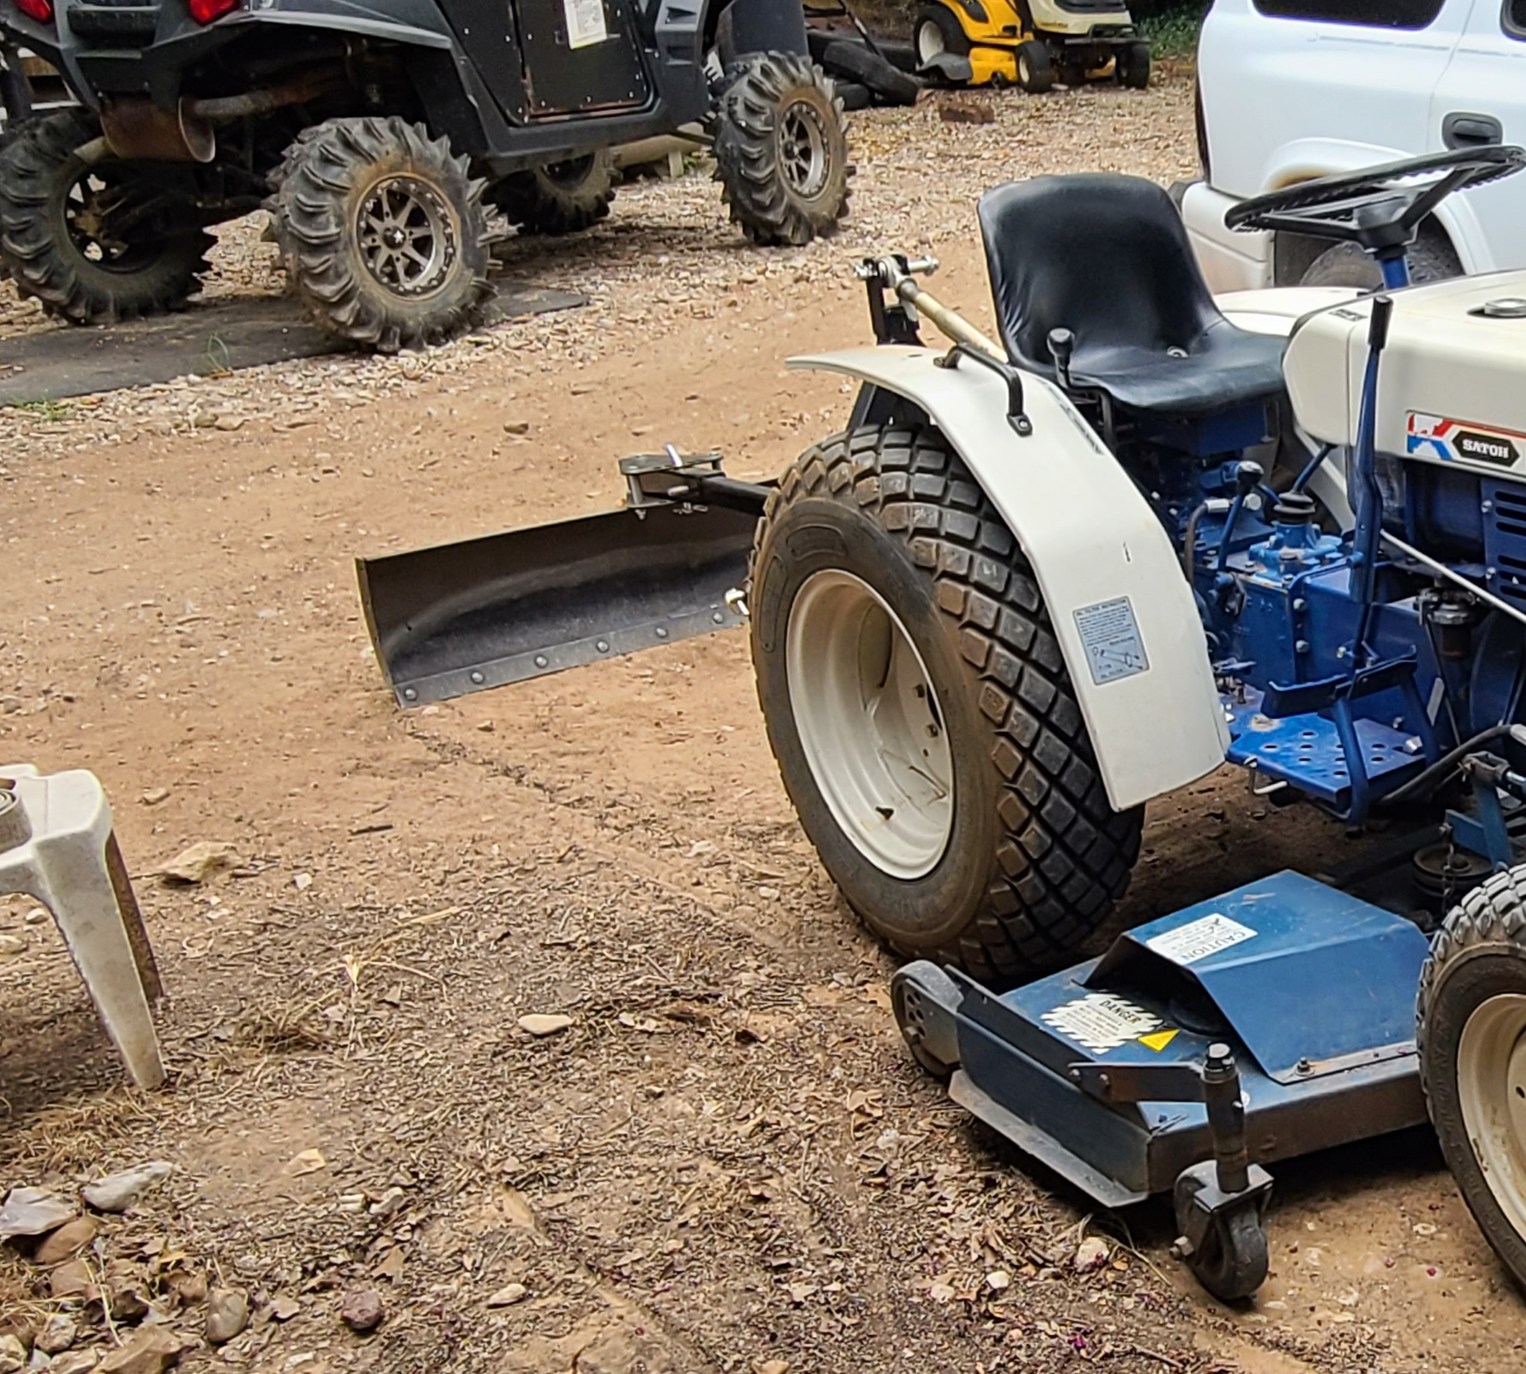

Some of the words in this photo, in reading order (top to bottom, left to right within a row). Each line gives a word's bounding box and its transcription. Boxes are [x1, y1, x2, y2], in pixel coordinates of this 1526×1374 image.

[1462, 438, 1509, 459] SATOH
[1182, 931, 1246, 961] CAUTION
[1099, 999, 1143, 1024] DANGER
